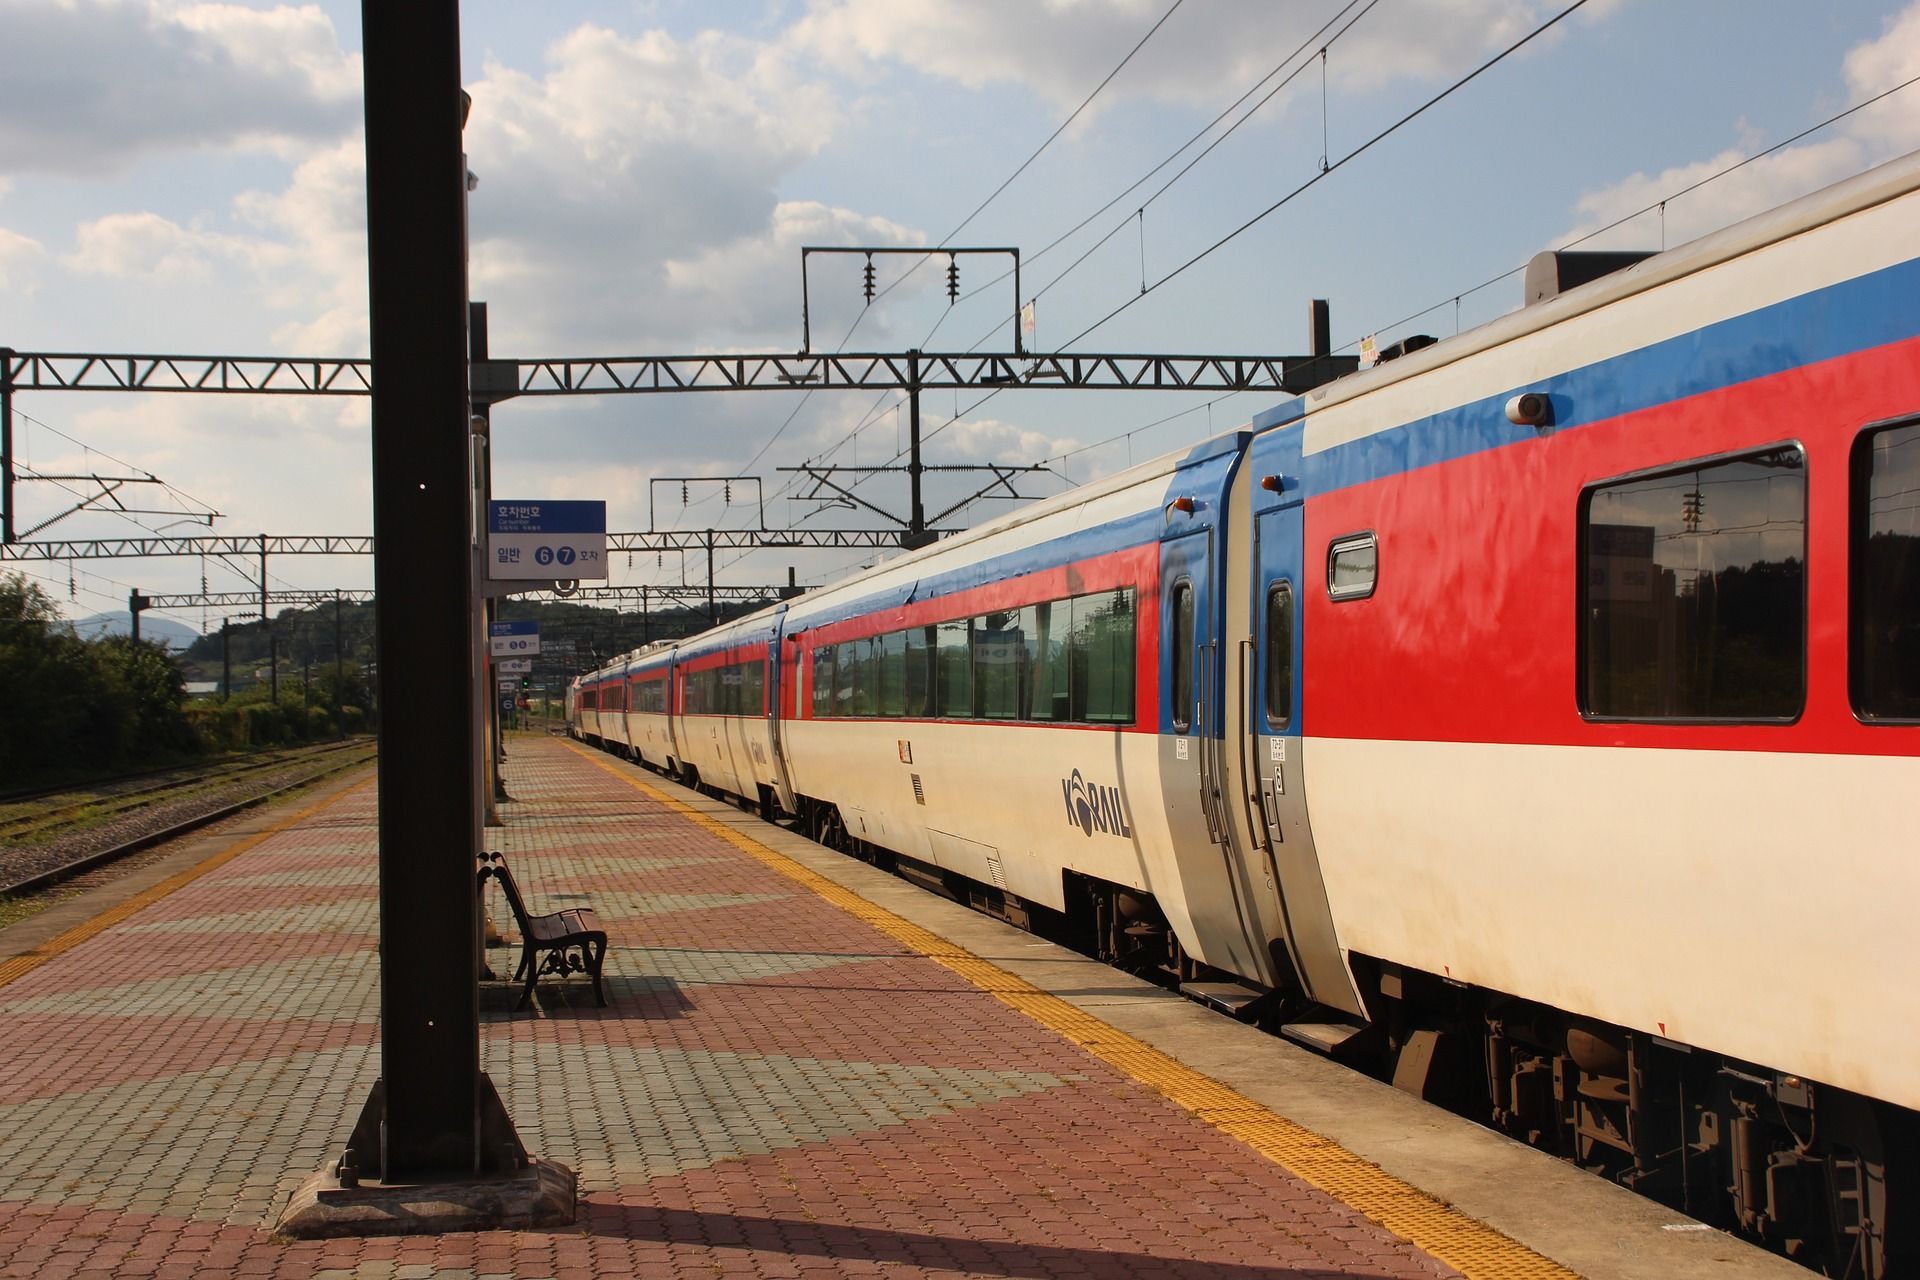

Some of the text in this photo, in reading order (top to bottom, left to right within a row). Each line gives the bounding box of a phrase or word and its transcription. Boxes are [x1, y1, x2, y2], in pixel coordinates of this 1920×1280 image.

[498, 506, 541, 519] 호차번호
[498, 547, 520, 563] 일반
[1061, 767, 1132, 838] KORAIL
